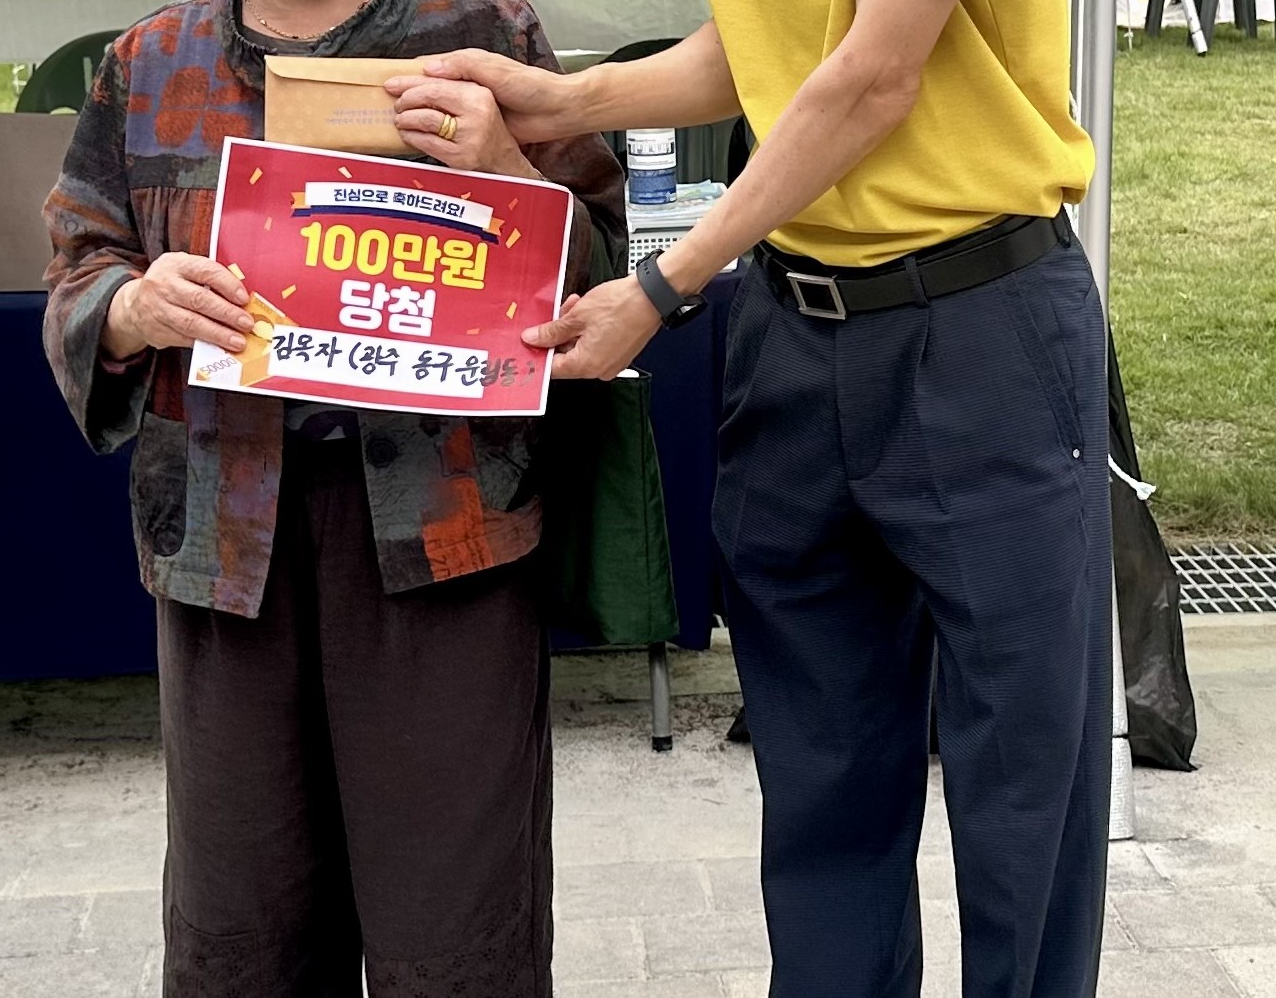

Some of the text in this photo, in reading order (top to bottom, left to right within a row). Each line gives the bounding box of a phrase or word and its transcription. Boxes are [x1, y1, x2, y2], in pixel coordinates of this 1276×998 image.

[333, 189, 465, 218] 진심으로 축하드려요!
[300, 221, 489, 290] 100만원
[339, 279, 437, 337] 당첨
[412, 350, 454, 382] 동구
